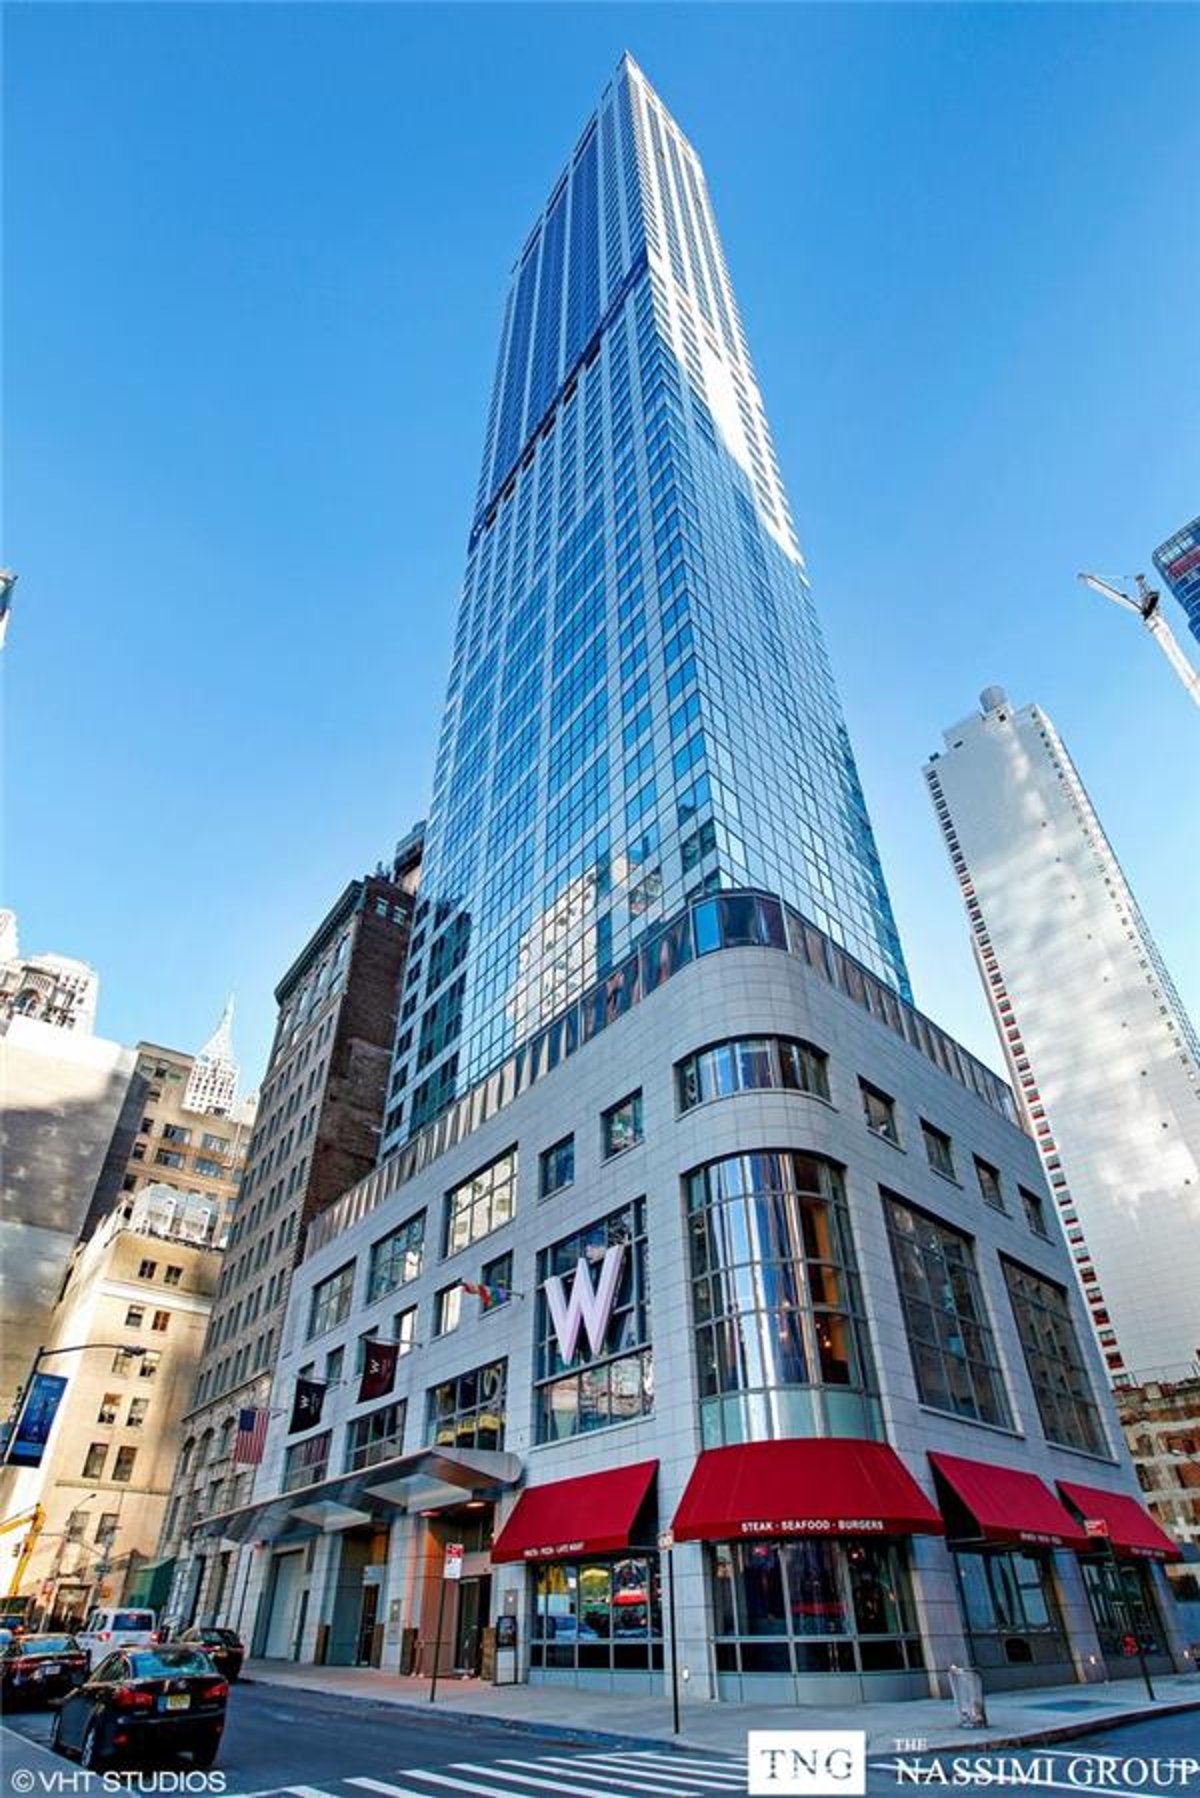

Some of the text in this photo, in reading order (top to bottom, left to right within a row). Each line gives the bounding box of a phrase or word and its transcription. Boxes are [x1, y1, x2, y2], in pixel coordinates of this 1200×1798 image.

[544, 1244, 624, 1365] W
[741, 1519, 884, 1532] STEAK SEAFOOD BURGERS
